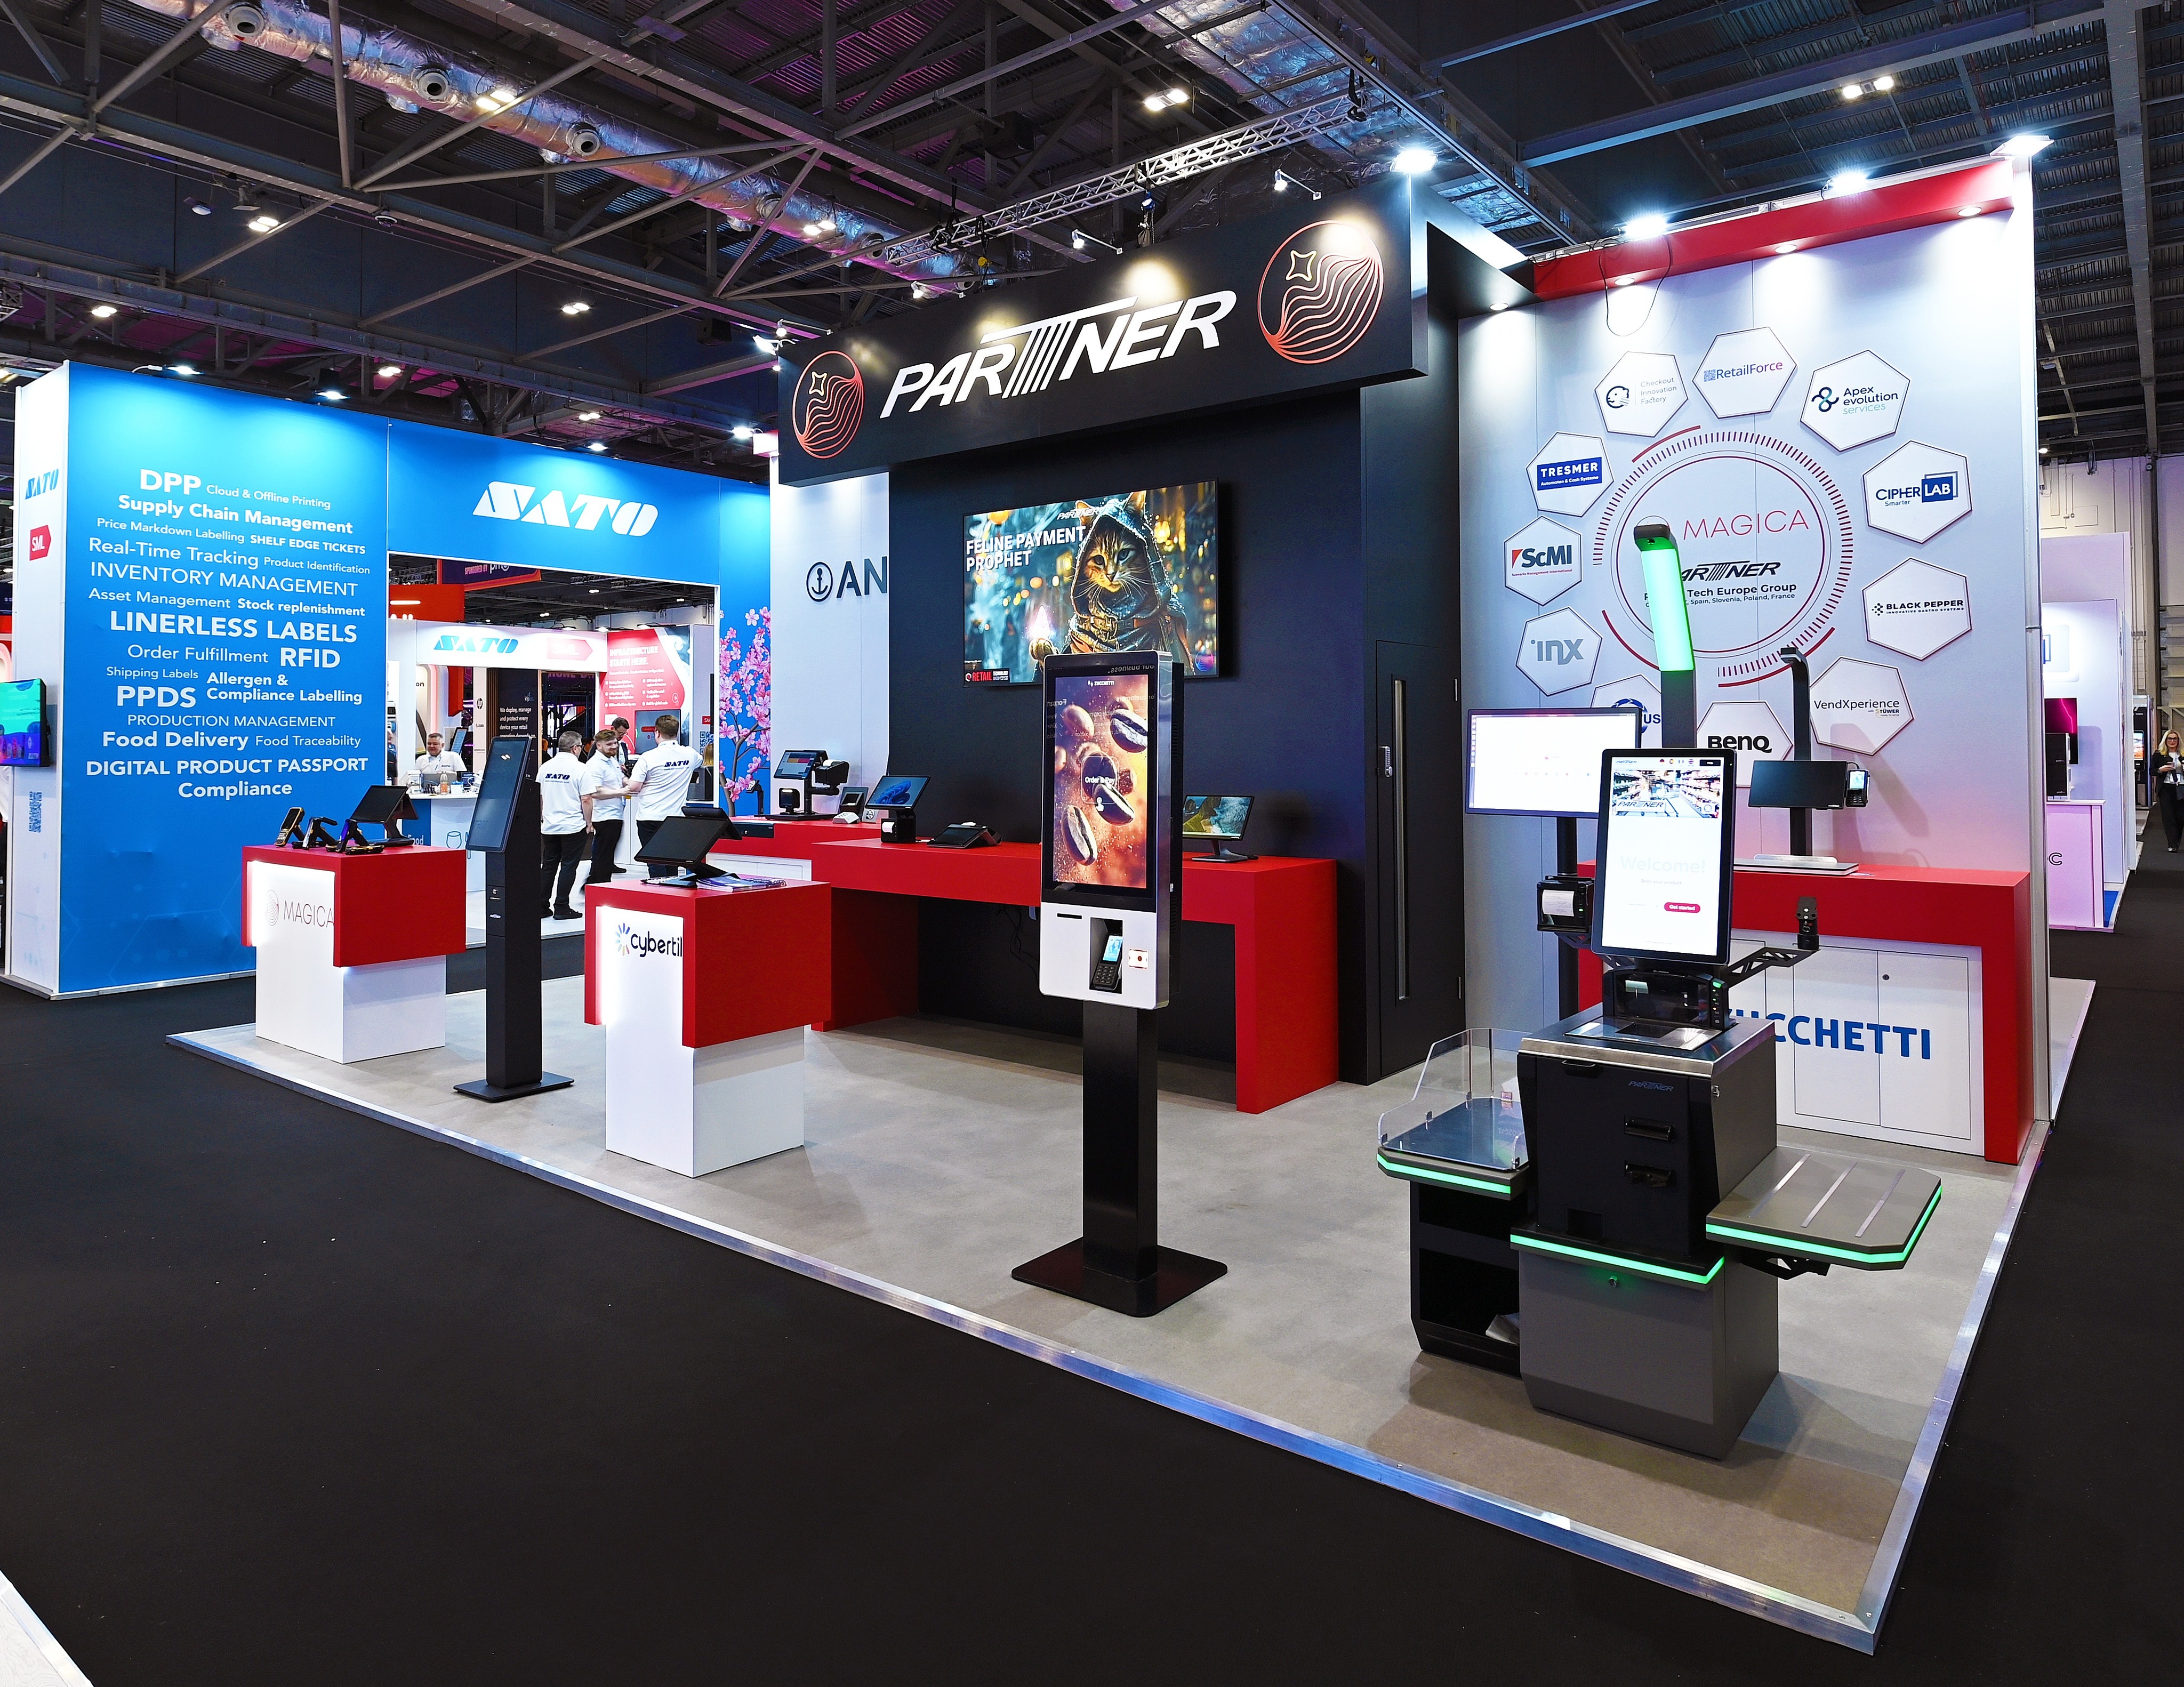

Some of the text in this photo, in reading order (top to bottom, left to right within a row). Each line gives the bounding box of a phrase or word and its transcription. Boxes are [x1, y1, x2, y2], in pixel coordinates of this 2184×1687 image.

[880, 290, 1236, 418] PARTNER
[1716, 361, 1782, 380] RetailForce
[1641, 377, 1674, 388] Checkout
[1641, 385, 1677, 396] Innovation
[1843, 385, 1874, 397] Apex
[1641, 396, 1667, 405] Factory
[1843, 391, 1898, 406] evolution
[1843, 403, 1886, 414] services
[1540, 462, 1598, 477] TRESMER
[25, 469, 59, 500] SATO
[140, 469, 331, 510] DPP Cloud & Offline Printing
[118, 495, 353, 534] Supply Chain Management
[472, 481, 659, 536] SATO
[1683, 509, 1809, 540] MAGICA
[32, 535, 45, 551] SML
[97, 518, 366, 555] Price Markdown Labelling SHELF EDGE TICKETS
[966, 526, 1086, 555] FELINE PAYMENT
[90, 537, 370, 574] Real-Time Tracking Product Identification
[966, 550, 1032, 572] PROPHET
[1521, 544, 1572, 568] ScMI
[91, 561, 358, 597] INVENTORY MANAGEMENT
[836, 556, 887, 598] AN
[1681, 560, 1781, 581] ARTNER
[1687, 583, 1797, 598] Tech Europe Group
[89, 587, 365, 616] Asset Management Stock replenishment
[110, 610, 357, 643] LINERLESS LABELS
[433, 635, 518, 654] SATO
[609, 646, 658, 656] INFRASTRUCTURE
[127, 644, 341, 668] Order Fulfillment RFID
[609, 657, 649, 667] STARTS HERE.
[107, 666, 198, 679] Shipping Labels
[206, 672, 288, 688] Allergen &
[972, 671, 992, 681] RETAIL
[117, 686, 196, 708] PPDS
[206, 687, 363, 704] Compliance Labelling
[1814, 700, 1899, 711] VendXperience
[128, 714, 336, 727] PRODUCTION MANAGEMENT
[102, 732, 361, 751] Food Delivery Food Traceability
[86, 758, 368, 775] DIGITAL PRODUCT PASSPORT
[178, 781, 293, 800] Compliance
[1618, 800, 1664, 809] PARTNER
[1620, 856, 1706, 873] Welcome!
[284, 901, 334, 927] MAGICA
[1729, 1009, 1931, 1060] CCHETTI
[1628, 1081, 1674, 1092] PARTNER
